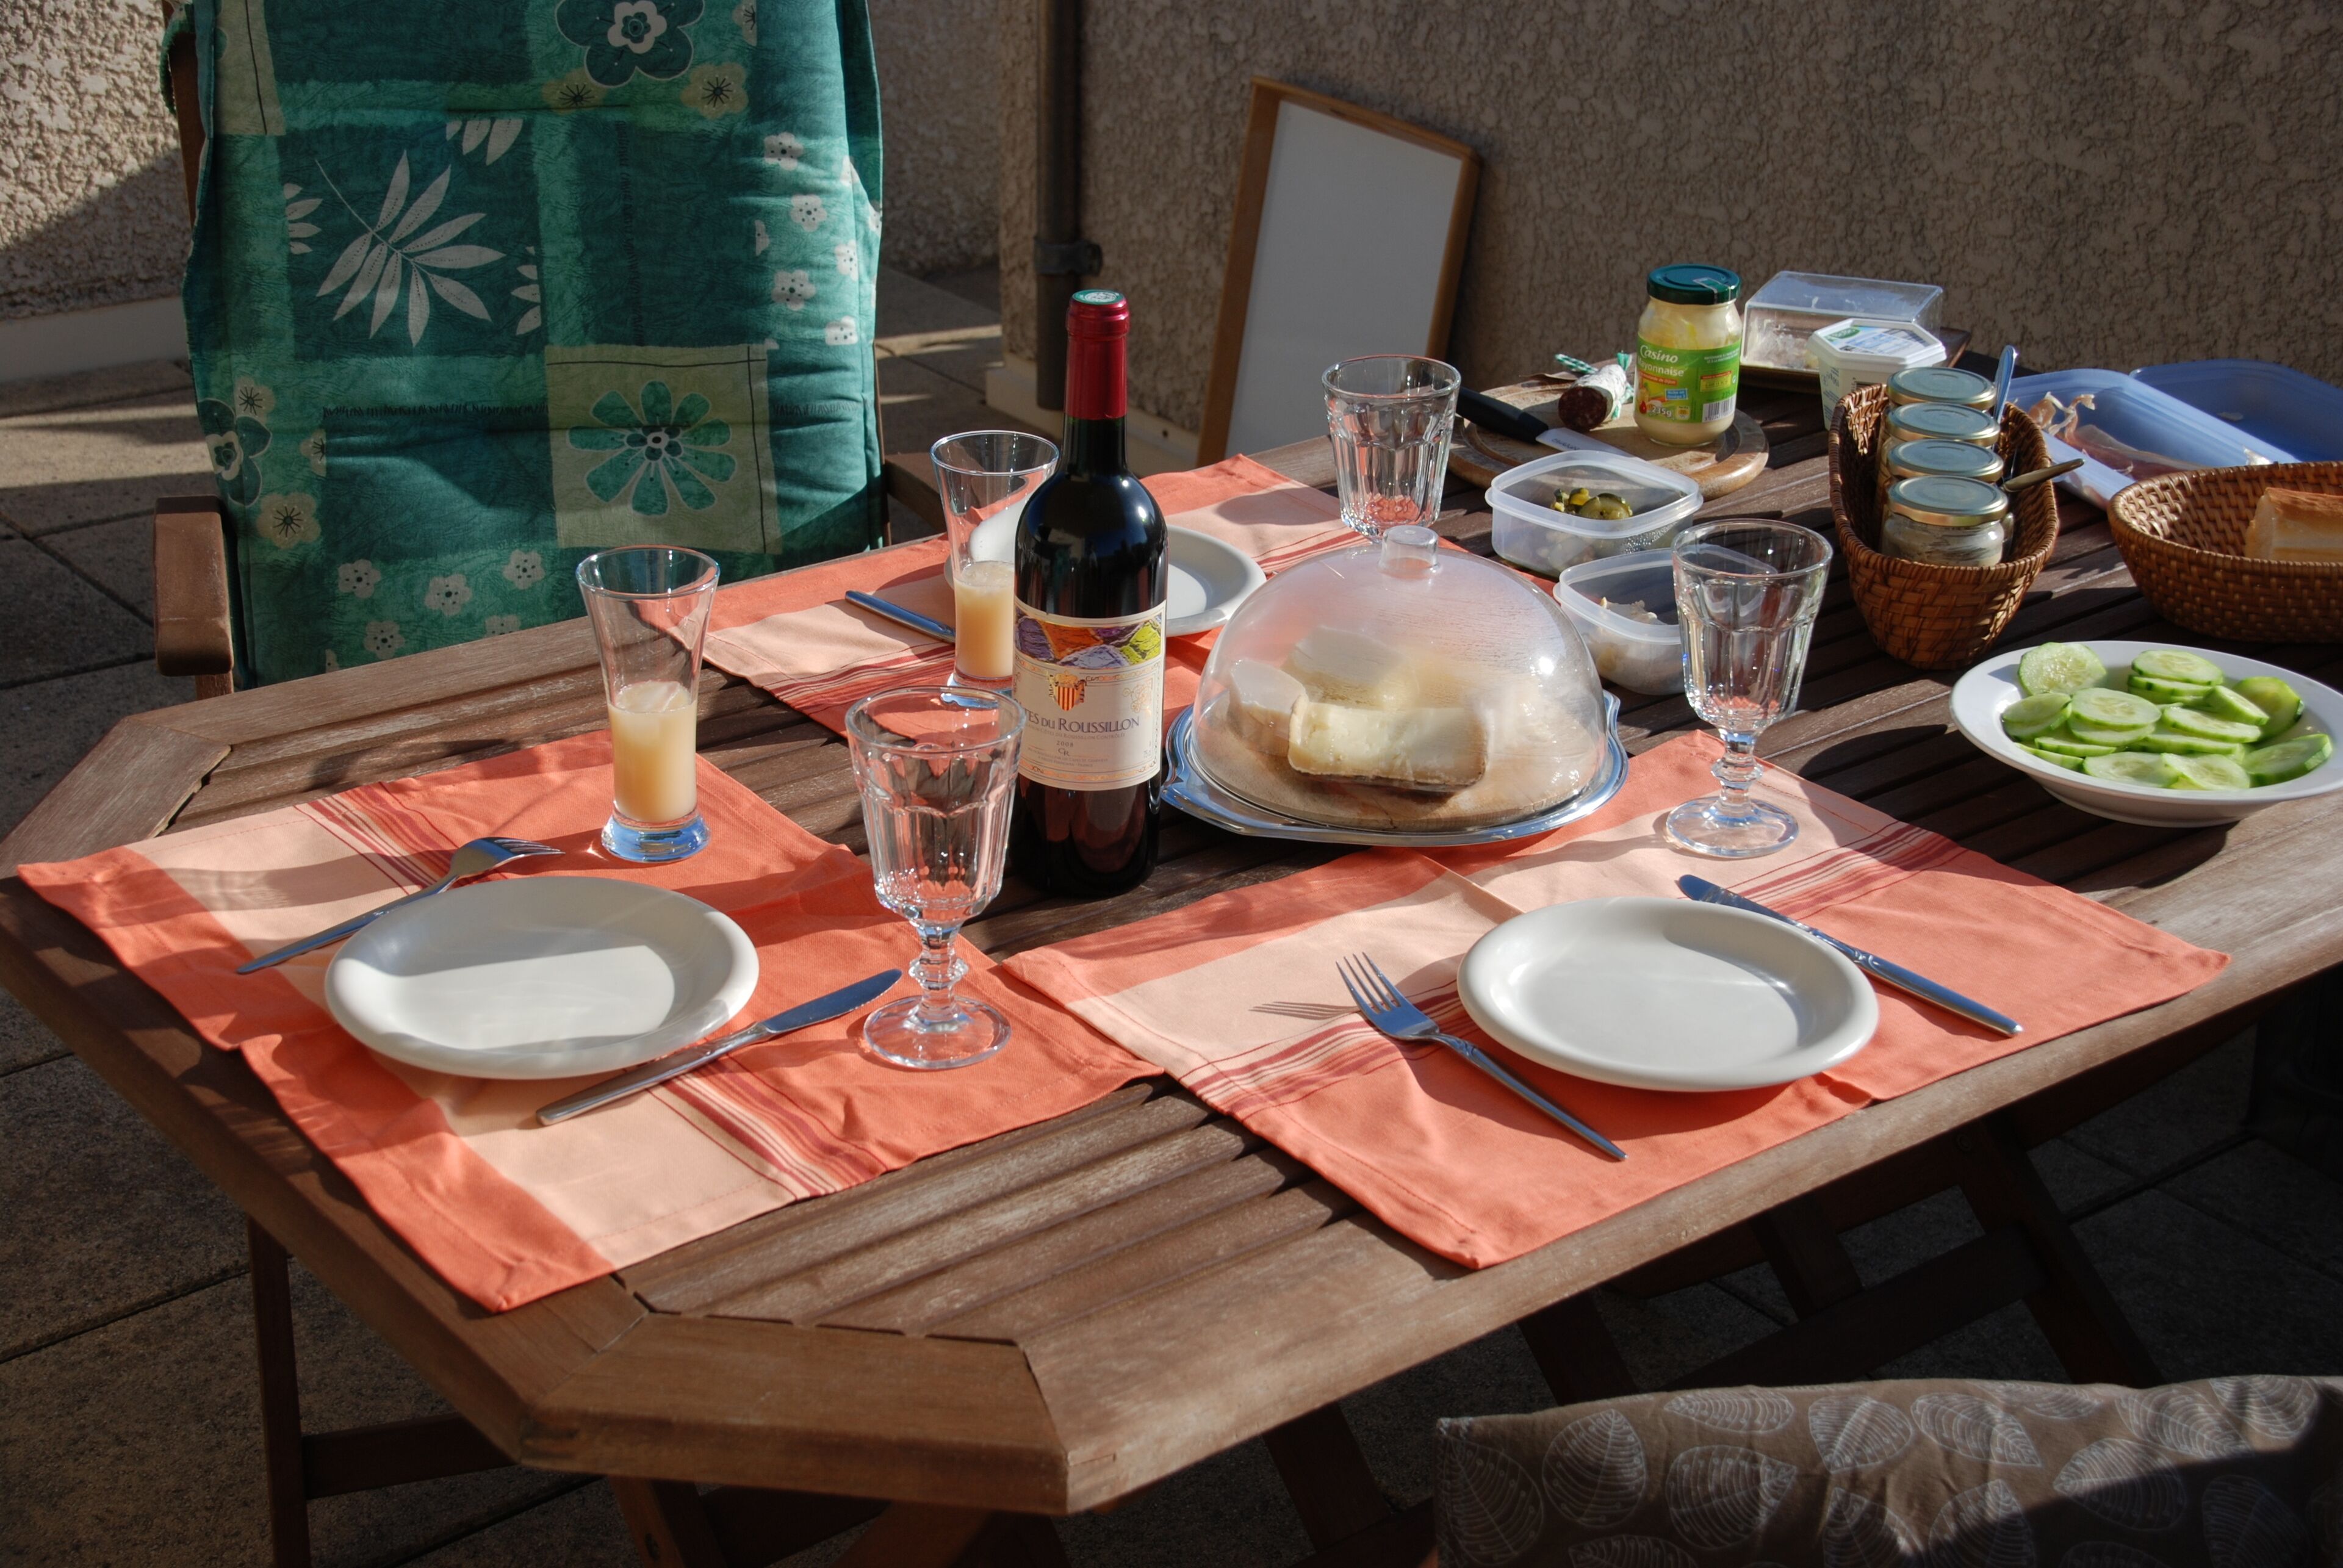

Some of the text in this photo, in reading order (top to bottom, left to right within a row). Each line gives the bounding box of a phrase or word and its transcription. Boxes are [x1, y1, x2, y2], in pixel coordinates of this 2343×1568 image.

[1639, 344, 1679, 363] Casino
[1652, 406, 1672, 417] 235g
[1022, 707, 1039, 724] TES
[1059, 717, 1140, 733] ROUSSILLON
